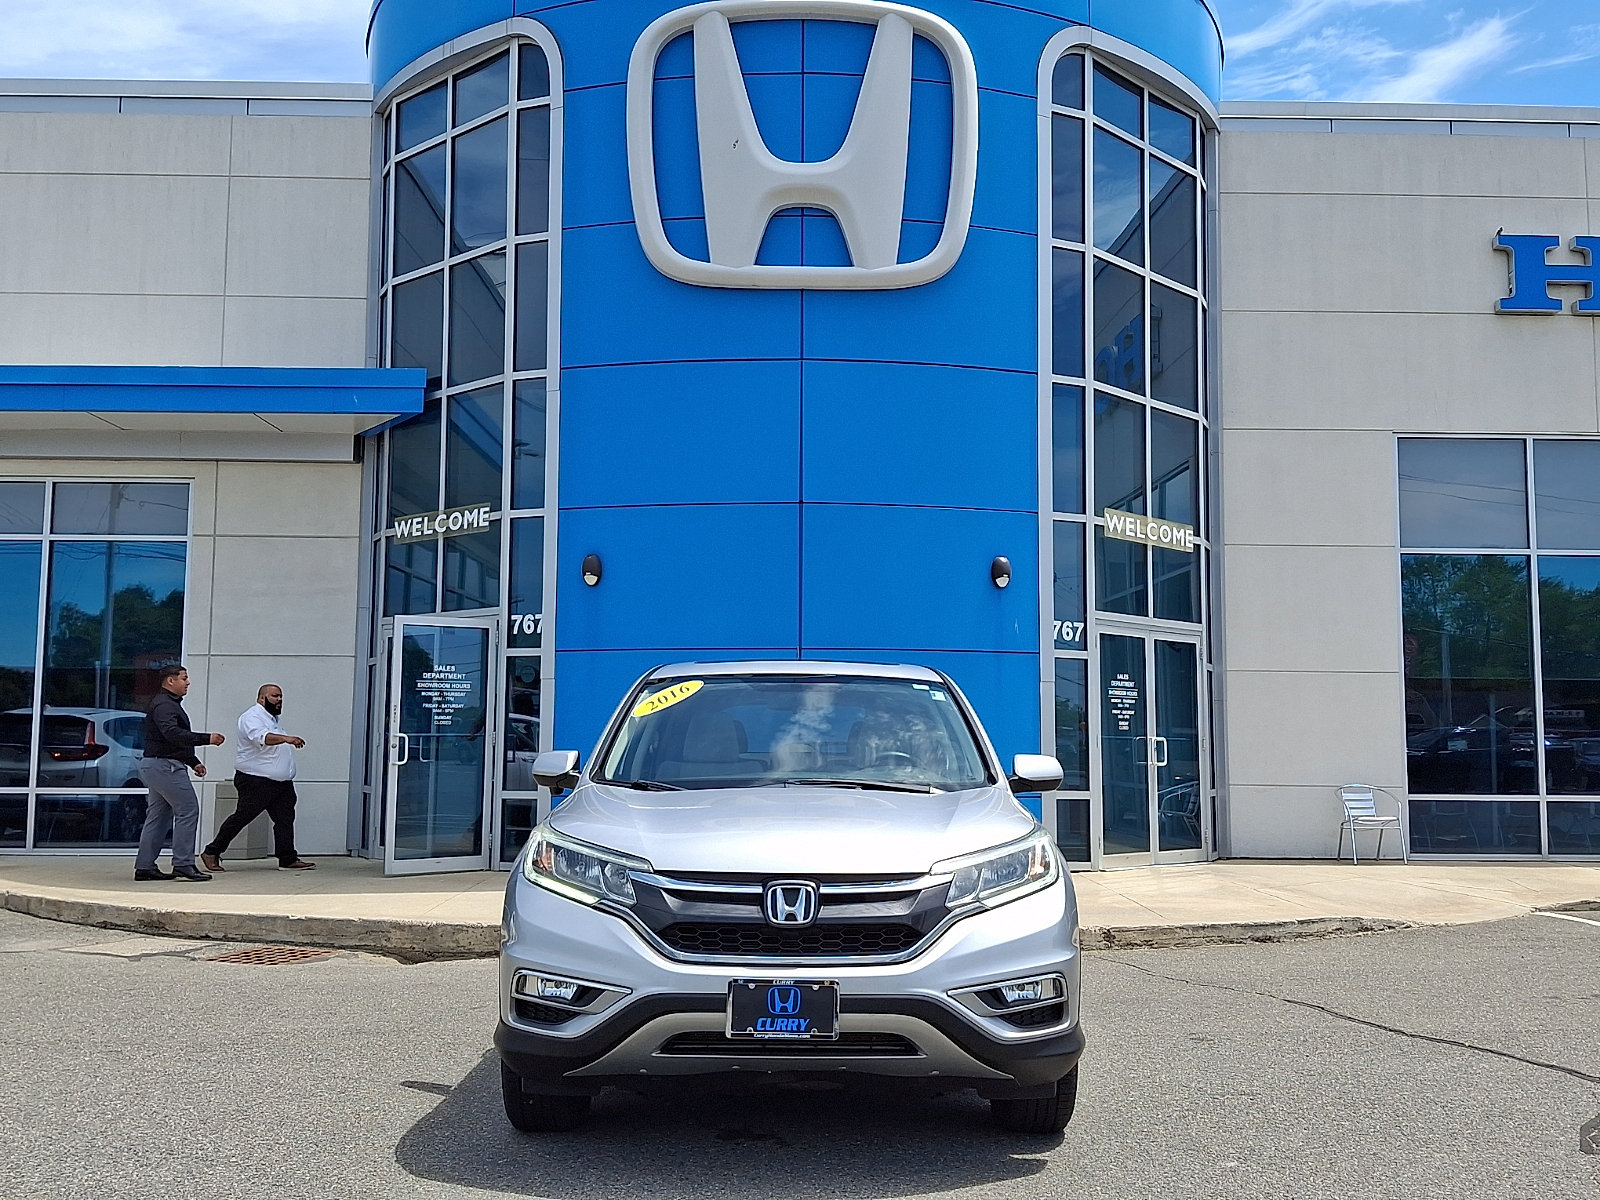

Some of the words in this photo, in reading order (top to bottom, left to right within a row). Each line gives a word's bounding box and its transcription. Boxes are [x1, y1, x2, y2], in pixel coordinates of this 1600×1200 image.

[1494, 233, 1600, 312] H
[394, 507, 490, 539] WELCOME
[1105, 512, 1193, 548] WELCOME
[511, 613, 543, 635] 767
[1053, 620, 1084, 642] 767
[645, 684, 690, 711] 2016
[756, 1017, 811, 1031] CURRY
